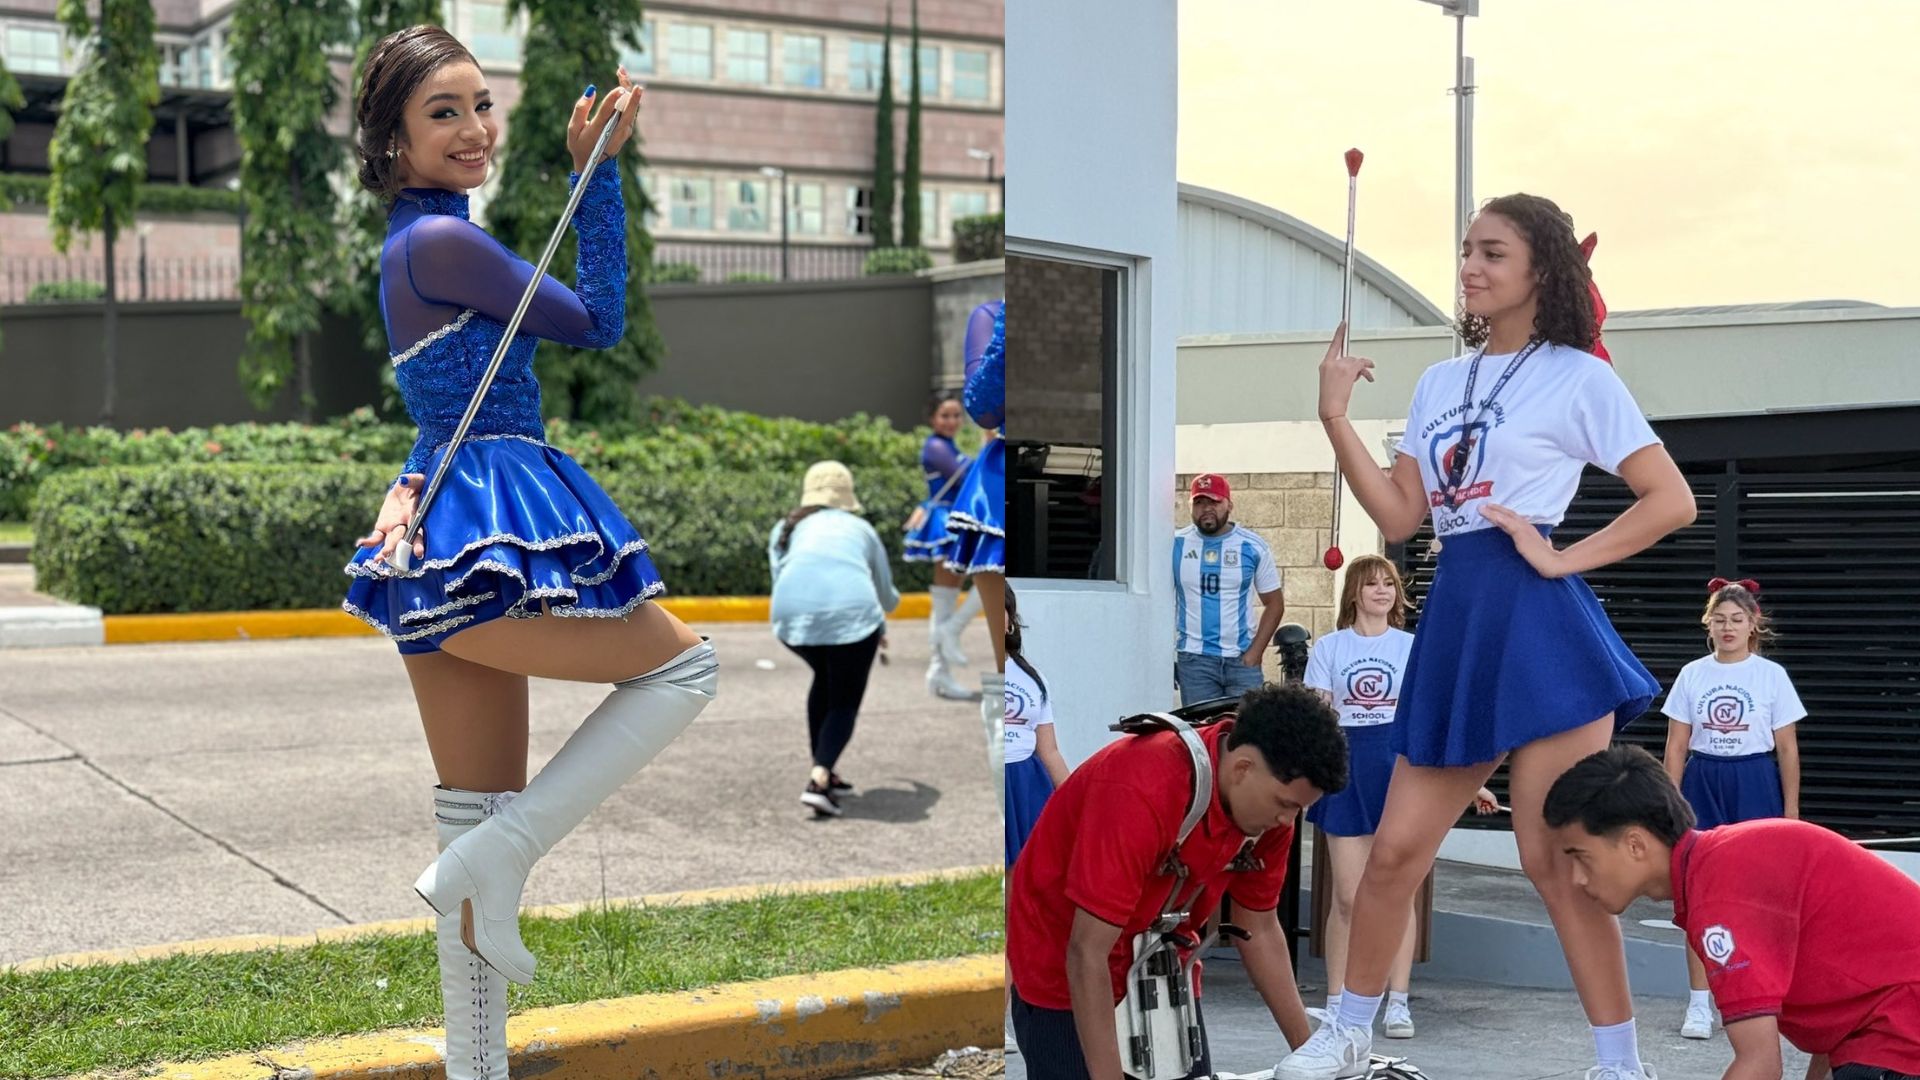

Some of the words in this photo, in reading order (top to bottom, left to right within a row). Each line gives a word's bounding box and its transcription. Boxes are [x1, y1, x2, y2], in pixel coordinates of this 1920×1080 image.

[1201, 573, 1220, 594] 10
[1005, 680, 1036, 708] ACIONAL
[1697, 685, 1724, 715] CULTURA
[1726, 684, 1755, 712] NACIONAL
